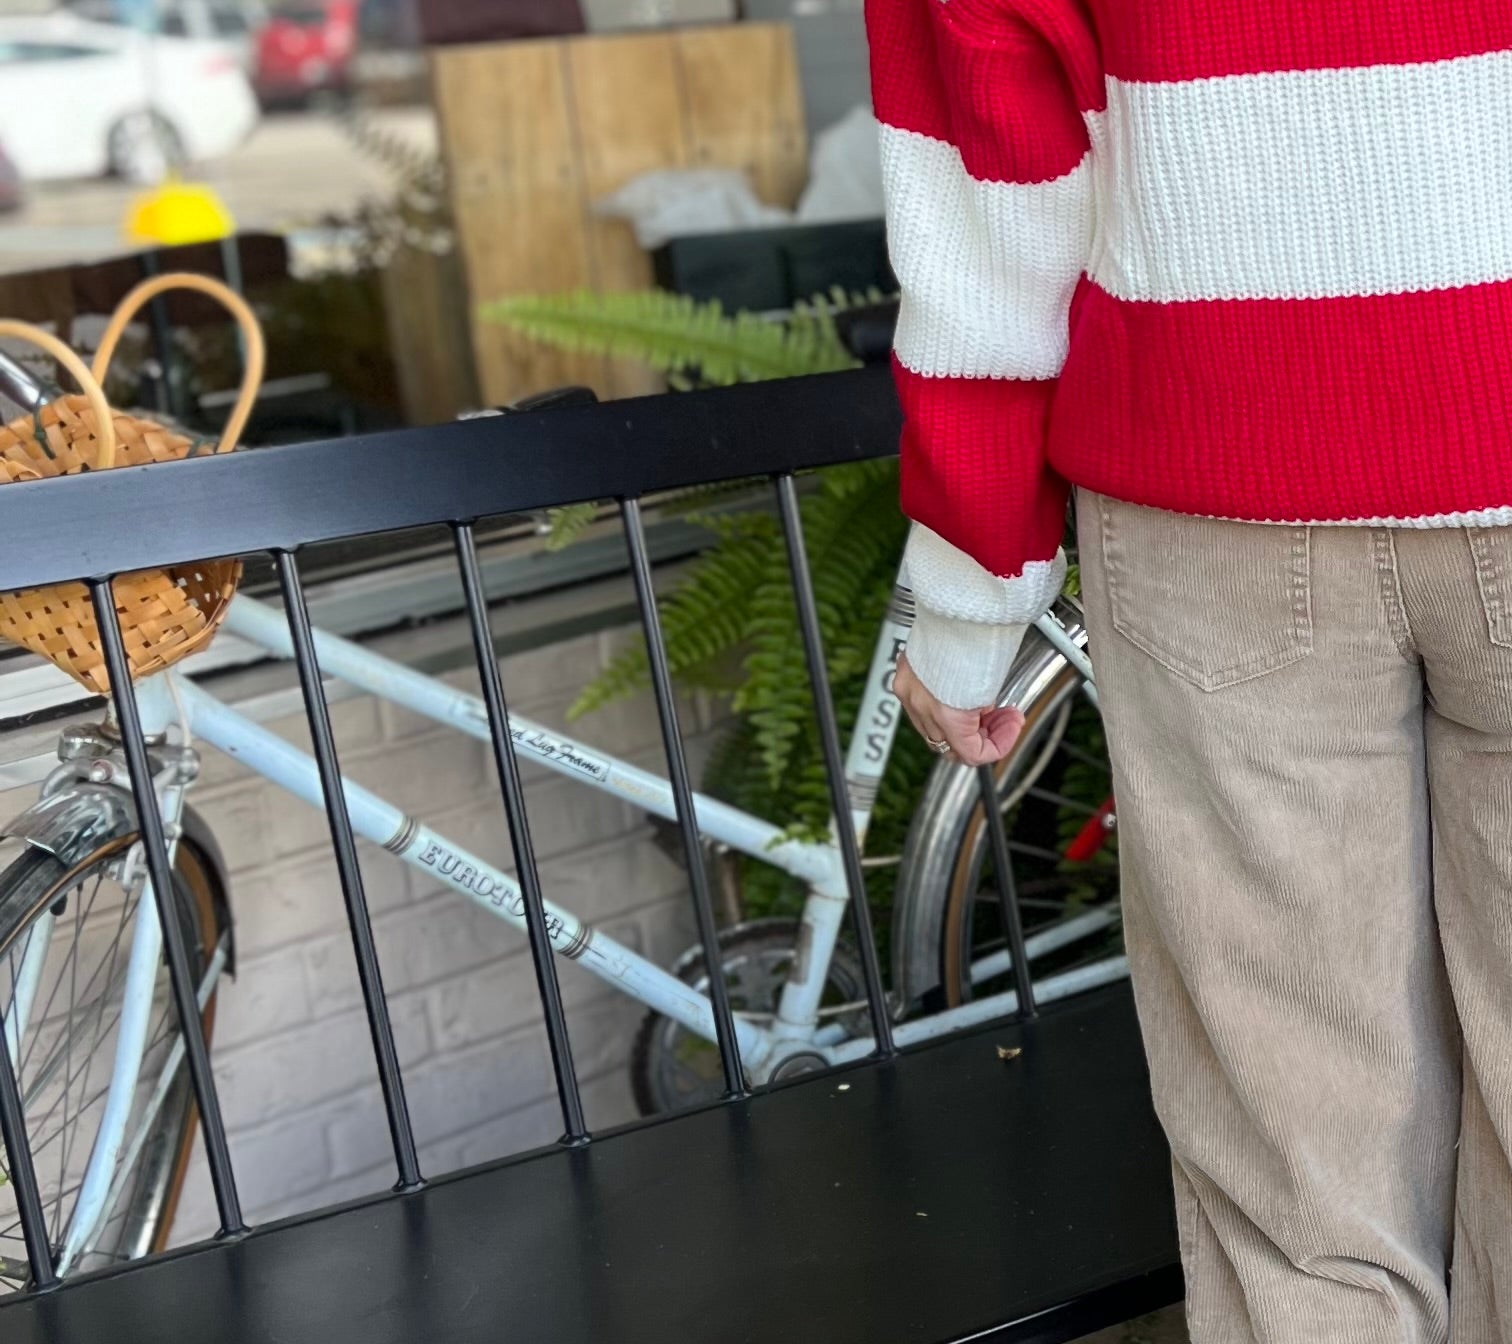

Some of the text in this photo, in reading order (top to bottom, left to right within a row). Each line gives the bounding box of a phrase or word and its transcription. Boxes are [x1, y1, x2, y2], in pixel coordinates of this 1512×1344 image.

[526, 733, 601, 774] Lug Frame
[418, 839, 565, 940] EUROTOR
